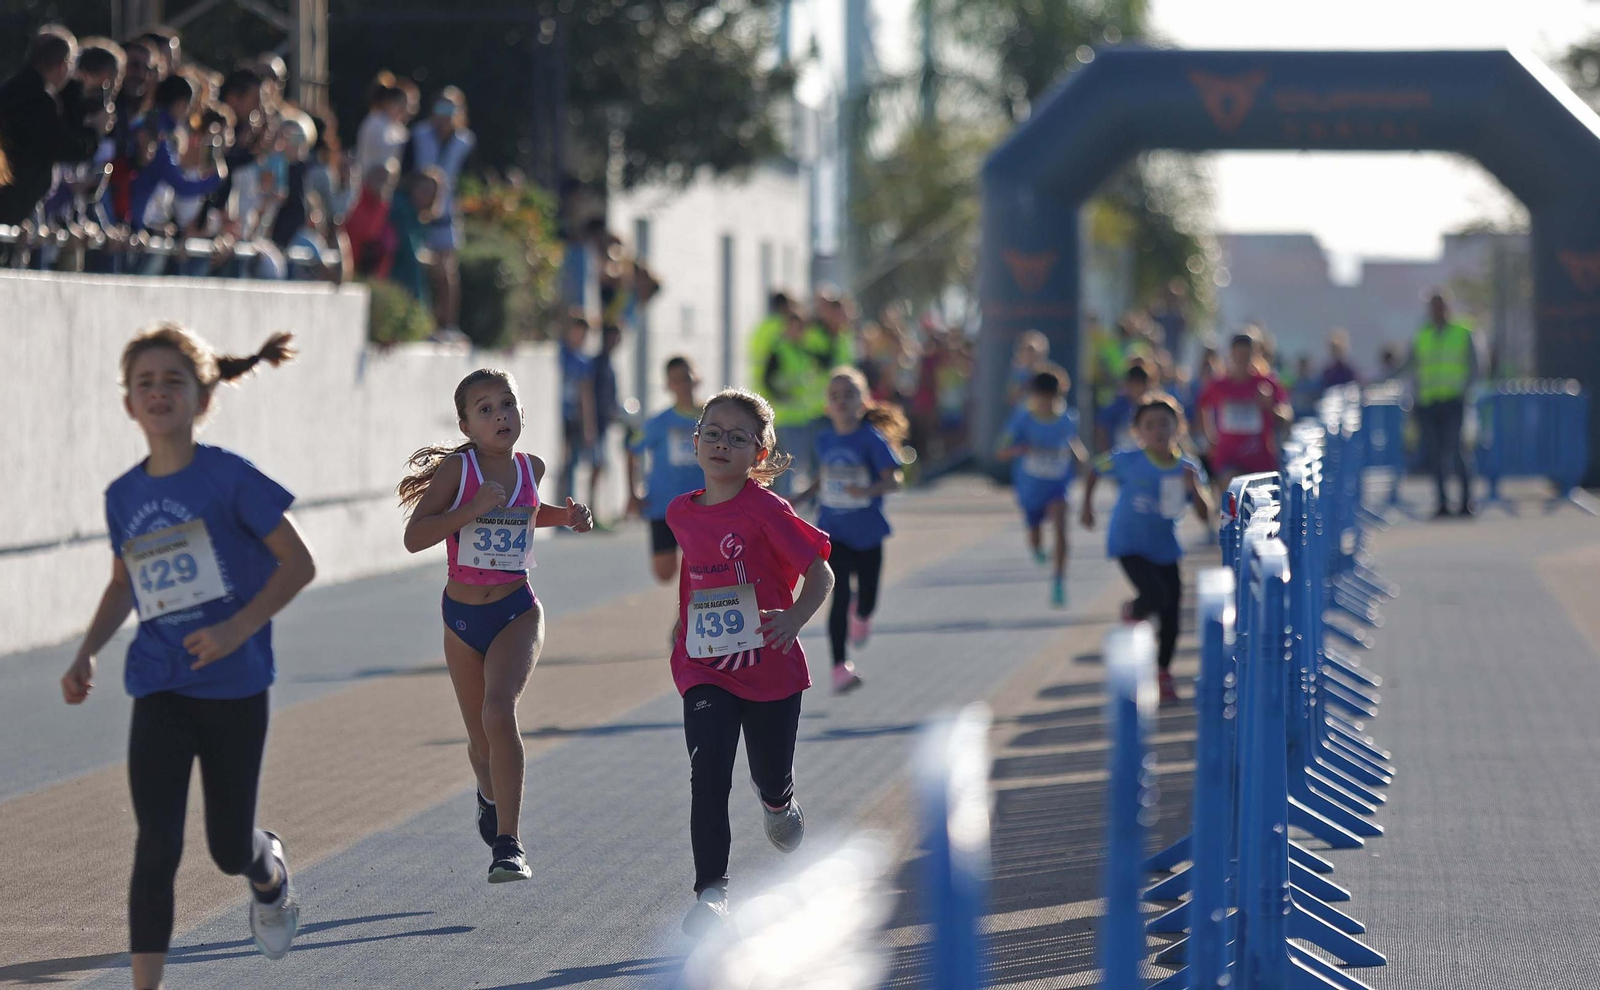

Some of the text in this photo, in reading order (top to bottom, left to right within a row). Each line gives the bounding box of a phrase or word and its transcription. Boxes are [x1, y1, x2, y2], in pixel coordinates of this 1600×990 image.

[476, 517, 496, 525] CIUDAD
[473, 527, 527, 552] 334
[139, 553, 198, 593] 429
[710, 598, 740, 608] ALGECIRAS
[695, 609, 745, 638] 439
